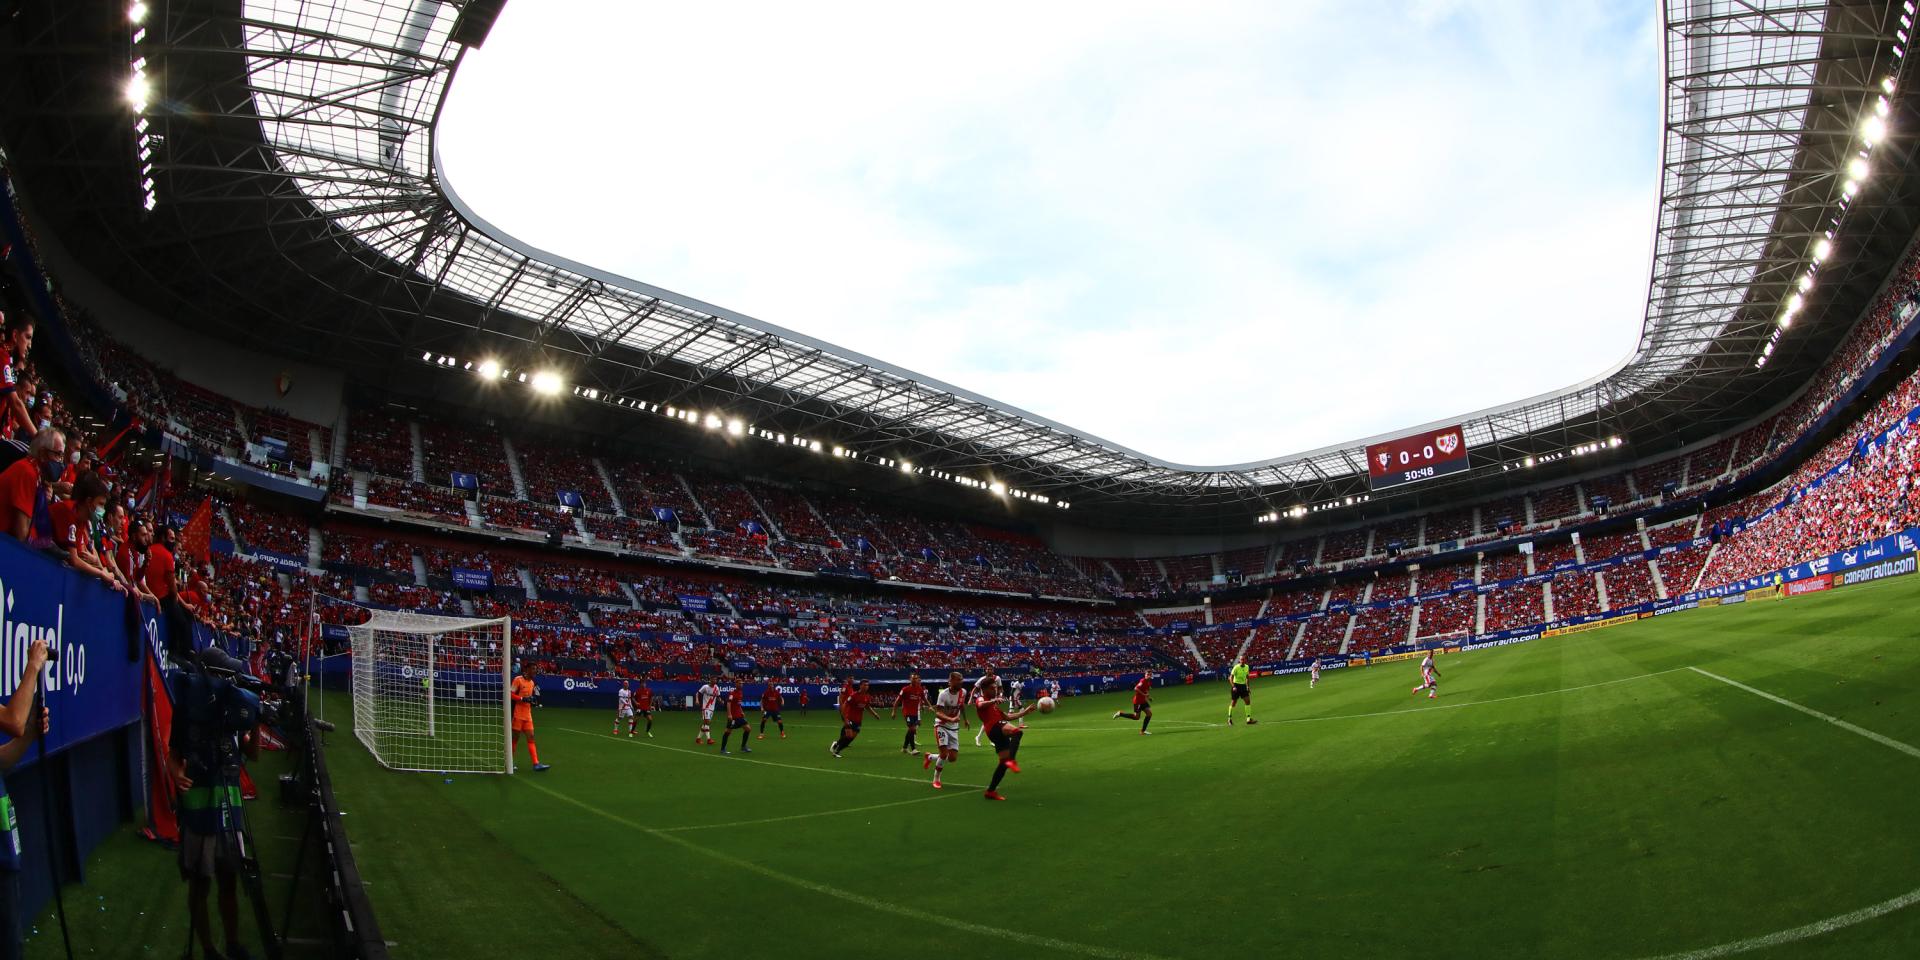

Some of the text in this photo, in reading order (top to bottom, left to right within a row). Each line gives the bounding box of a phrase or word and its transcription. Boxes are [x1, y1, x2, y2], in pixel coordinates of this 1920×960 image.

[1400, 451, 1409, 464] 0
[1423, 446, 1433, 459] 0
[1405, 467, 1433, 481] 30:48
